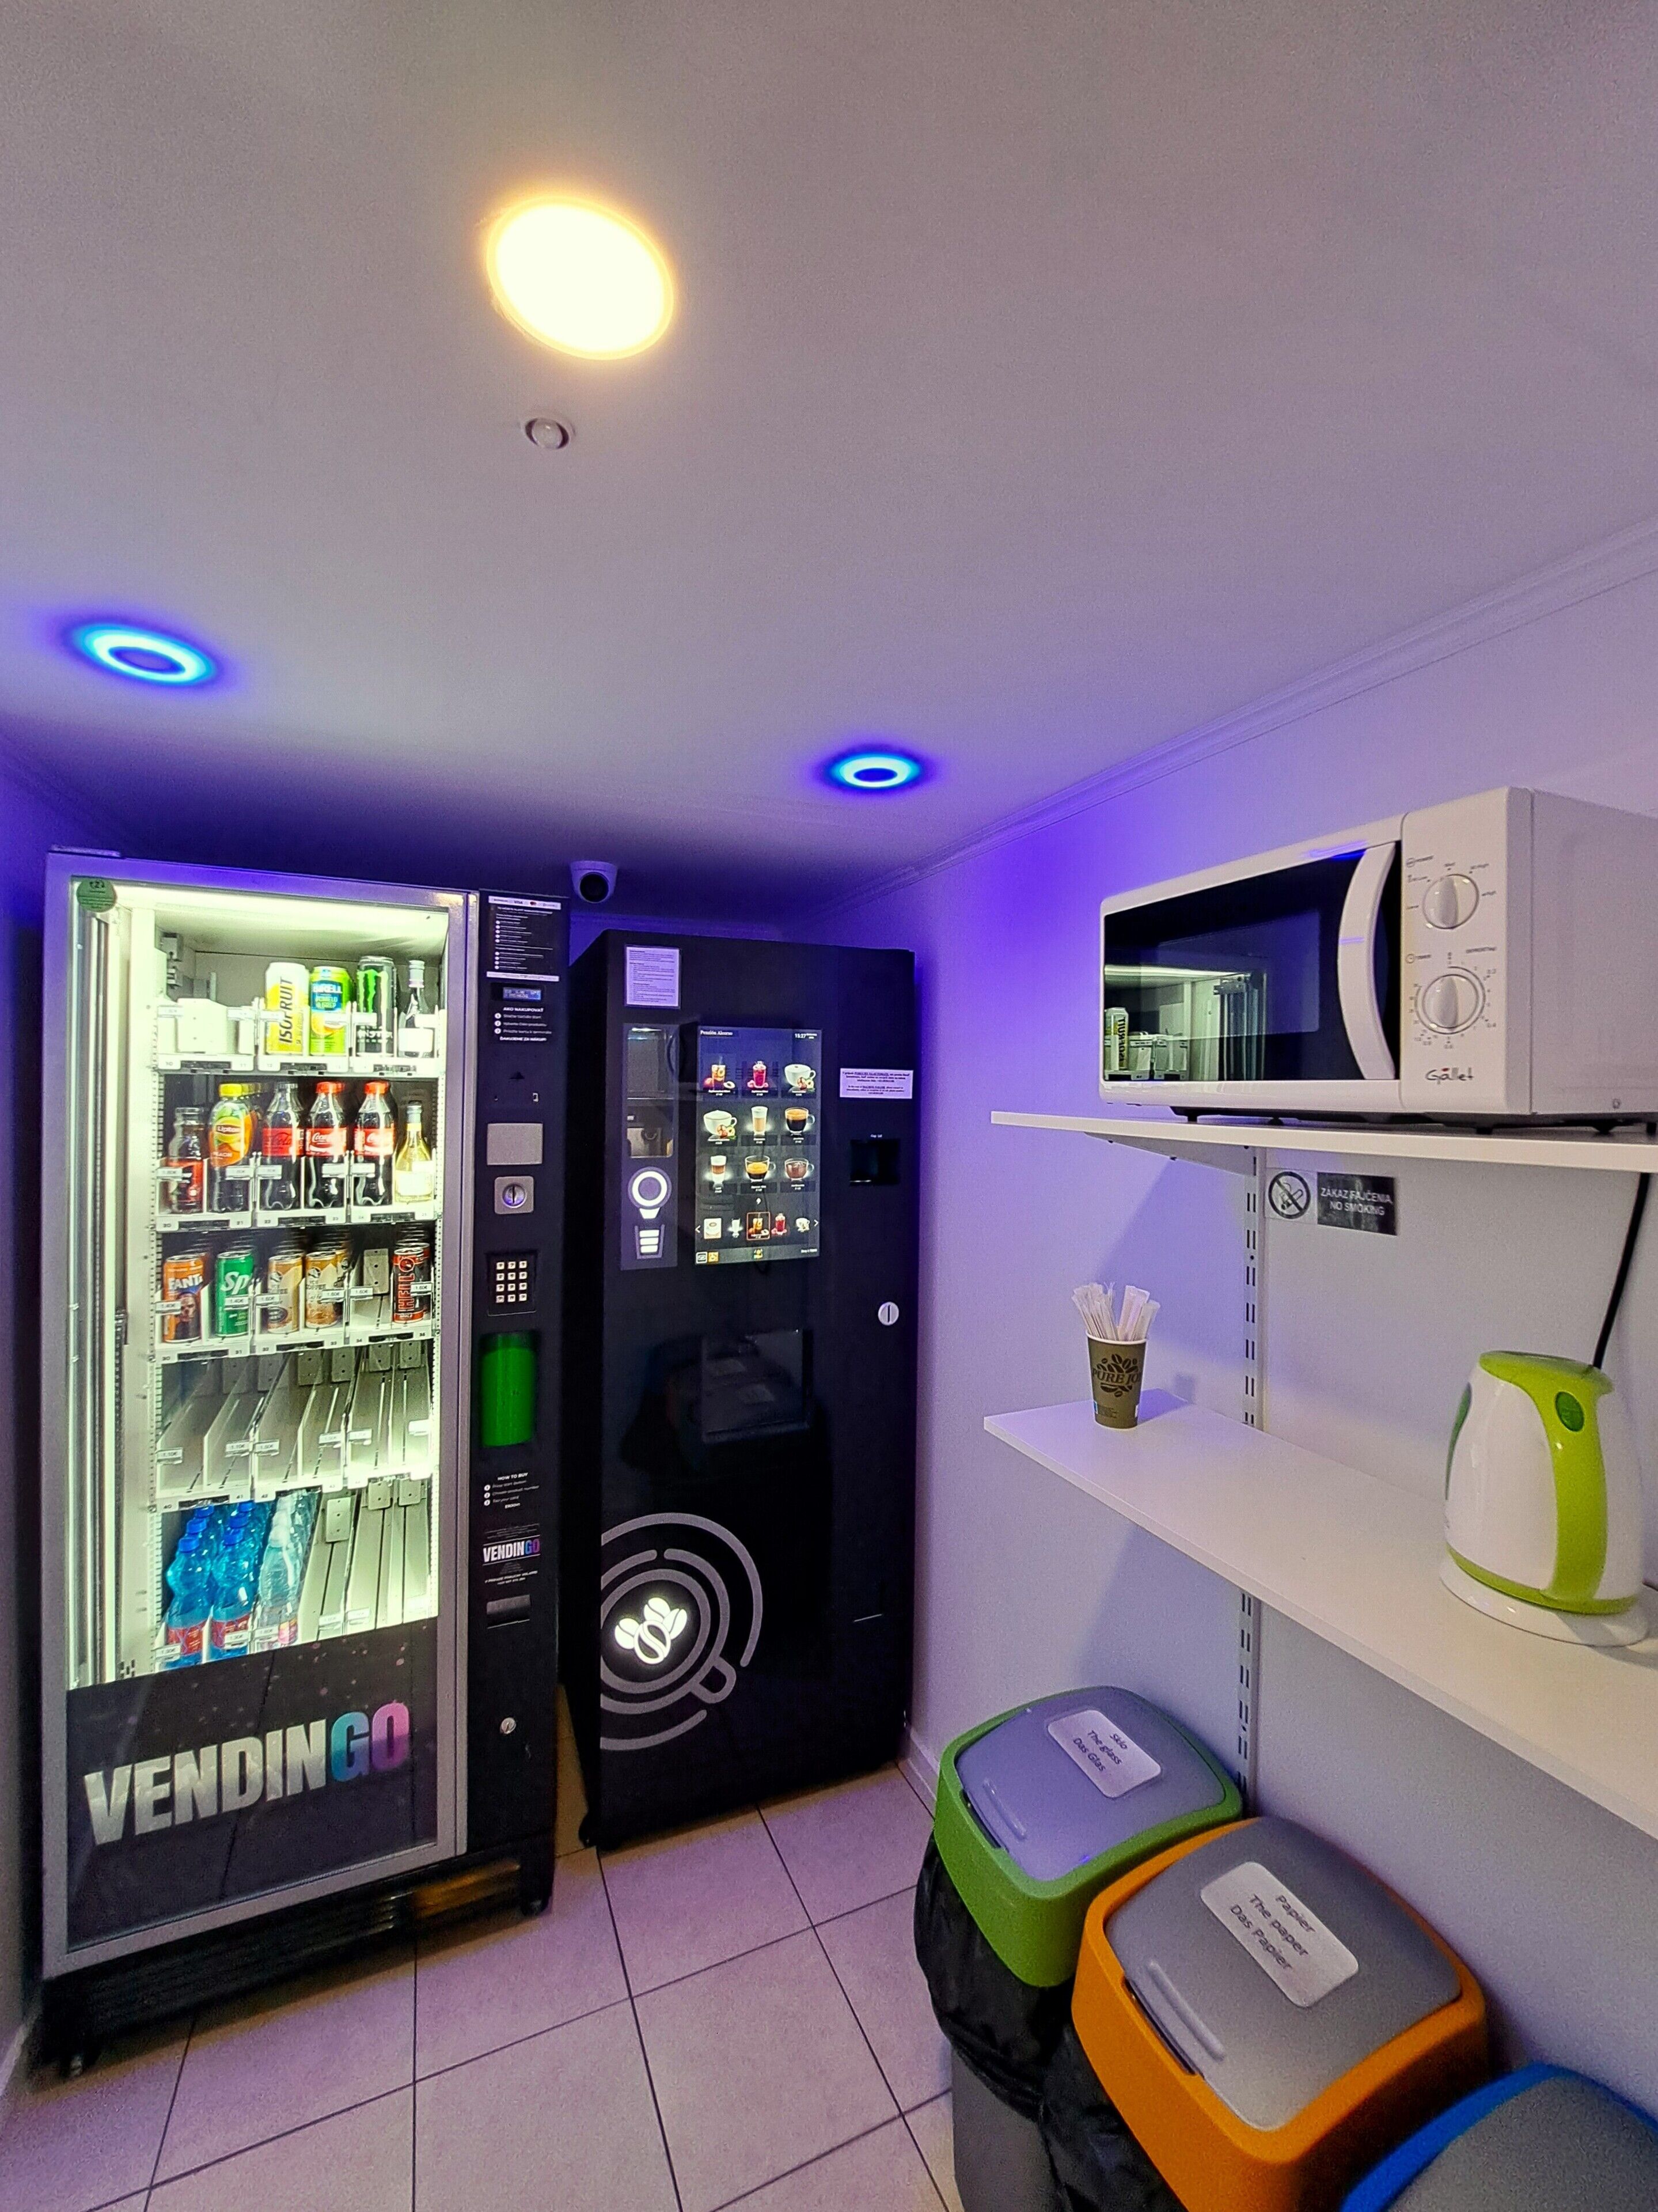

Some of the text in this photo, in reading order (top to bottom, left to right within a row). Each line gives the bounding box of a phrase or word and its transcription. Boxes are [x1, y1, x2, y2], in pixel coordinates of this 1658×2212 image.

[1321, 1187, 1349, 1199] ZÁKAZ
[1329, 1201, 1343, 1210] NO
[483, 1539, 540, 1563] VENDINGO
[1073, 1738, 1106, 1771] Das Glas
[1087, 1730, 1122, 1765] The glass
[1109, 1733, 1128, 1749] Sklo
[84, 1700, 410, 1845] VENDINGO
[1249, 1894, 1308, 1956] The paper
[1276, 1895, 1316, 1933] Papier
[1230, 1904, 1293, 1969] Das Papier
